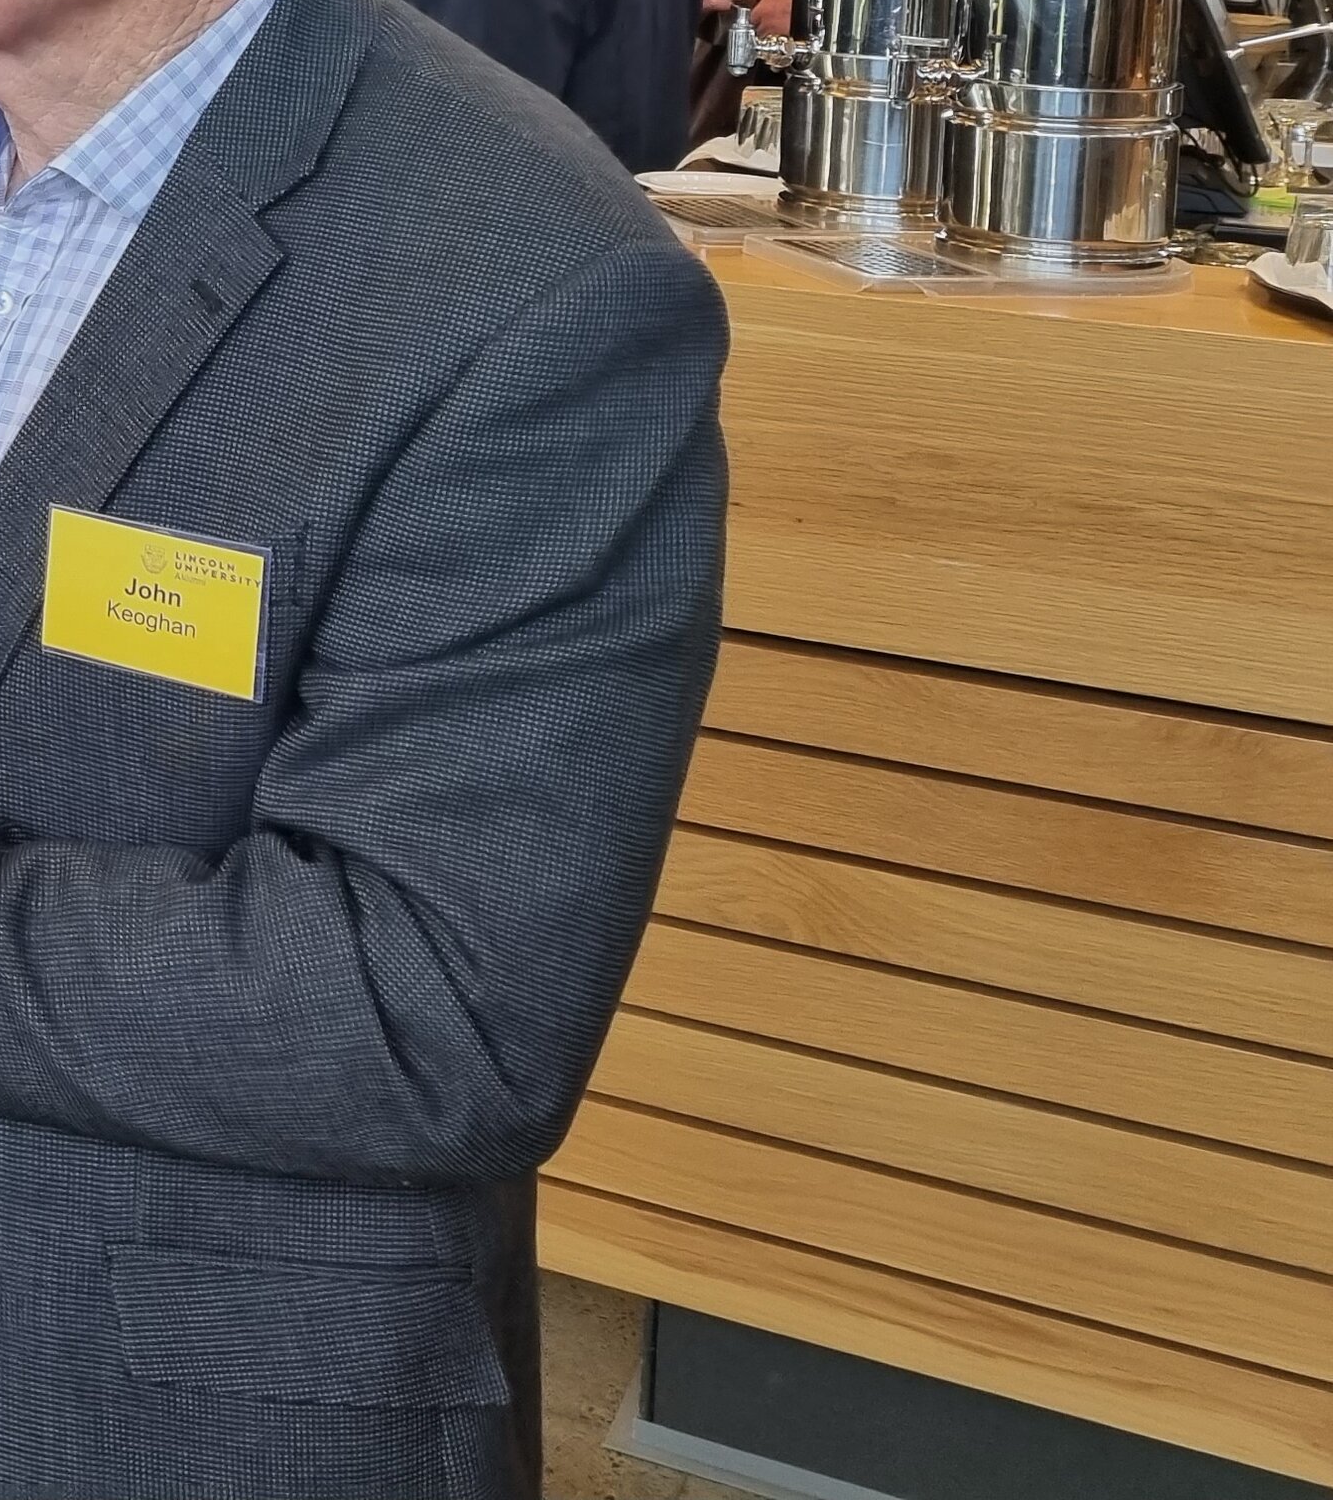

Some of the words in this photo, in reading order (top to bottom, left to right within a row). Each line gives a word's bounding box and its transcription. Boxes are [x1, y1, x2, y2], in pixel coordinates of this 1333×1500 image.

[175, 551, 235, 572] LINCOLN
[175, 562, 262, 589] UNIVERSITY
[124, 577, 182, 608] John
[107, 599, 197, 638] Keoghan
